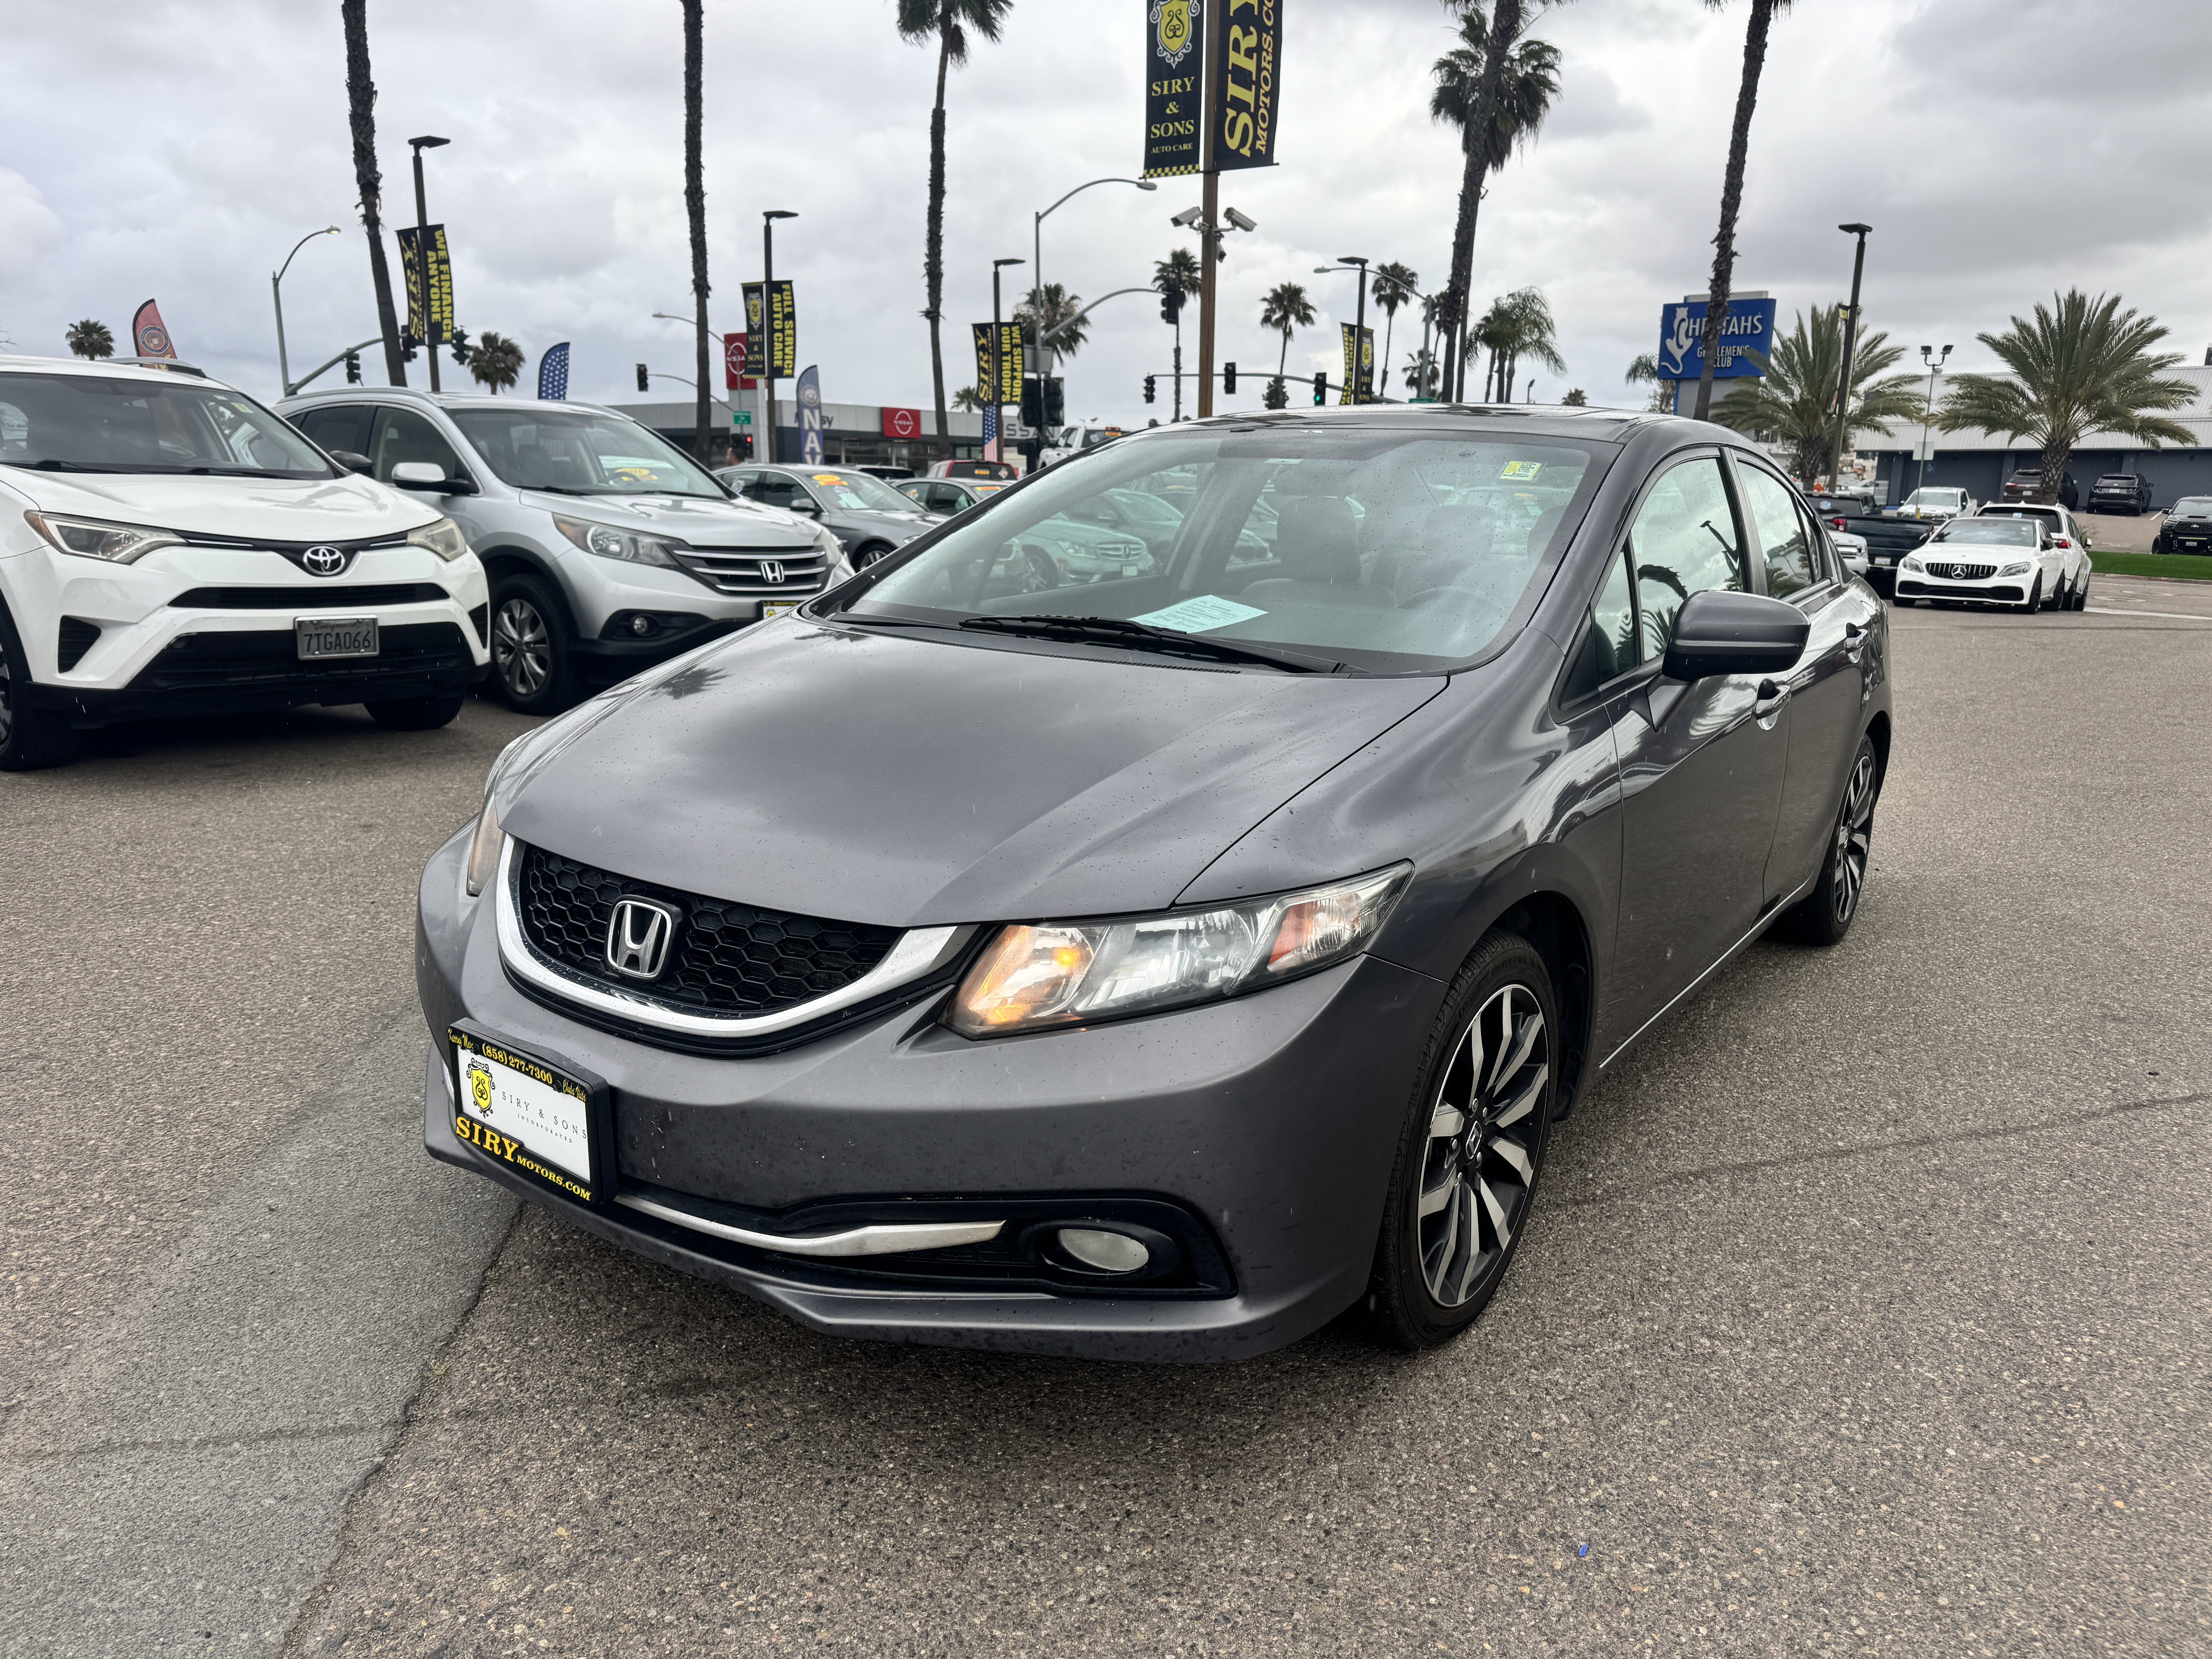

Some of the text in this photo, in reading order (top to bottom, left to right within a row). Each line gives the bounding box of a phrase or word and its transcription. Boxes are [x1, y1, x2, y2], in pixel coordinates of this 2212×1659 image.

[1152, 76, 1195, 96] SIRY
[1166, 101, 1180, 114] &
[1151, 119, 1194, 139] SONS
[1151, 143, 1193, 154] AUTO CARE
[427, 251, 441, 323] ANYONE
[434, 229, 453, 341] WE FINANCE
[772, 293, 783, 367] AUTO CARE
[781, 284, 794, 376] FULL SERVICE
[1676, 315, 1763, 349] CHTAHS
[975, 328, 988, 402] SIRY
[1001, 327, 1012, 402] OUR TROOPS
[1011, 326, 1023, 402] WE SUPPORT
[304, 630, 371, 652] 7TGA066
[482, 1043, 553, 1084] (858) 277-7300
[502, 1092, 586, 1139] SIRY & SONS
[517, 1113, 572, 1143] INCORPORATED
[456, 1116, 591, 1201] SIRY MOTORS.COM
